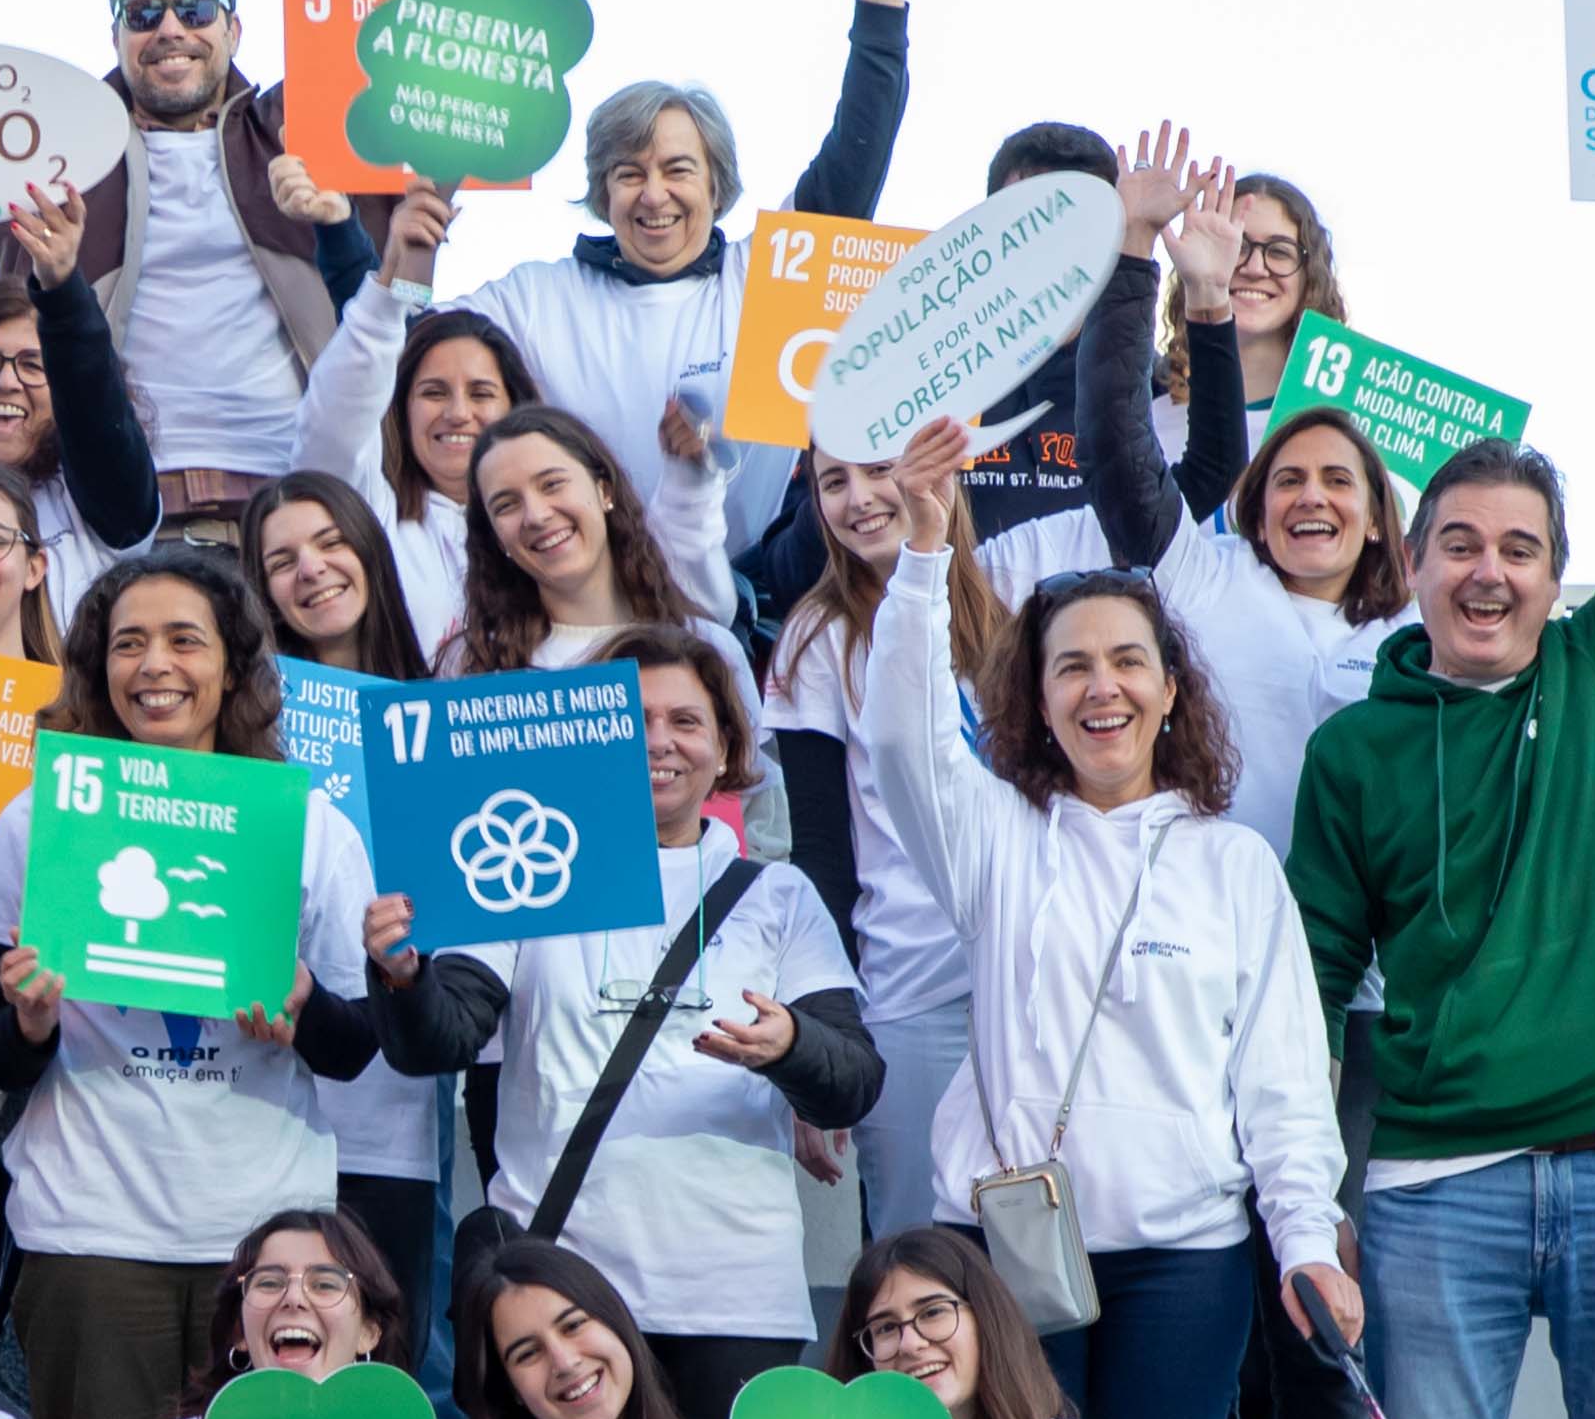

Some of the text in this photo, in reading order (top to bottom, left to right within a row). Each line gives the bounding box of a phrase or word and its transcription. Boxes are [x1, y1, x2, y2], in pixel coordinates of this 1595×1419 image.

[372, 26, 555, 94] A FLORESTA
[390, 104, 505, 148] O QUE RESTA
[395, 84, 510, 126] NÃO PERCAS
[769, 228, 814, 282] 12
[898, 222, 984, 293] POR UMA
[830, 186, 1076, 386] POPULAÇÃO ATIVA
[917, 287, 1018, 371] E POR UMA
[866, 263, 1095, 451] FLORESTA NATIVA
[1303, 335, 1352, 397] 13
[1354, 385, 1436, 440] MUDANÇA
[1362, 357, 1504, 433] AÇÃO CONTRA A
[1373, 424, 1426, 463] CLIMA
[2, 679, 16, 702] E
[297, 679, 361, 718] JUSTIÇ
[447, 682, 628, 725] PARCERIAS E MEIOS
[383, 700, 432, 764] 17
[450, 714, 635, 758] DE IMPLEMENTAÇÃO
[52, 753, 104, 814] 15
[119, 756, 169, 789] VIDA
[116, 790, 238, 834] TERRESTRE
[131, 1046, 220, 1061] o mar
[196, 1068, 225, 1082] em
